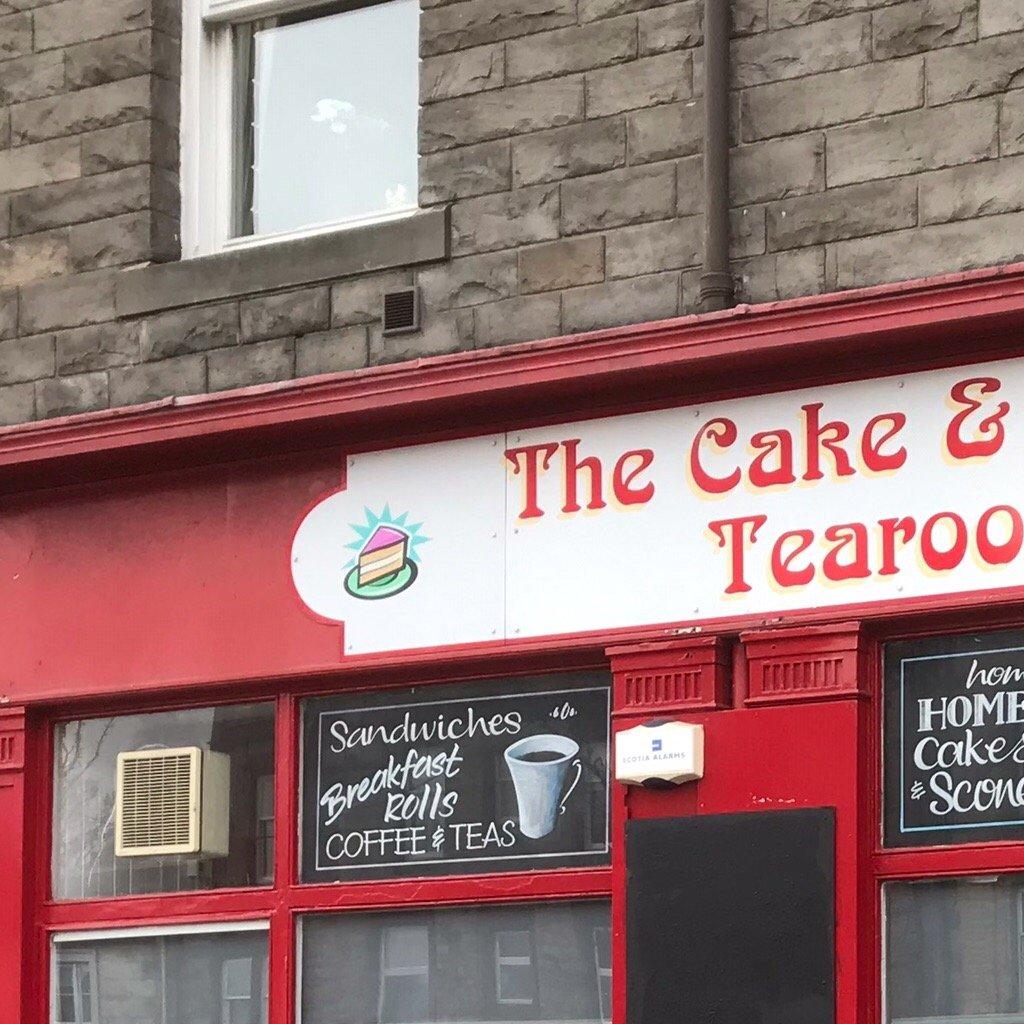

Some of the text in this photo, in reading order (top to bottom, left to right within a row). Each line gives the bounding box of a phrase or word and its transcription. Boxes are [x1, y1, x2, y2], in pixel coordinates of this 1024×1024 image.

[503, 438, 655, 522] The
[687, 402, 908, 495] Cake
[943, 375, 1011, 460] &
[330, 707, 522, 754] Sandwiches
[653, 752, 686, 761] ALARMS
[319, 743, 464, 826] Breakfast
[383, 782, 459, 823] Rolls
[911, 780, 926, 800] &
[325, 820, 516, 860] COFFEE & TEAS
